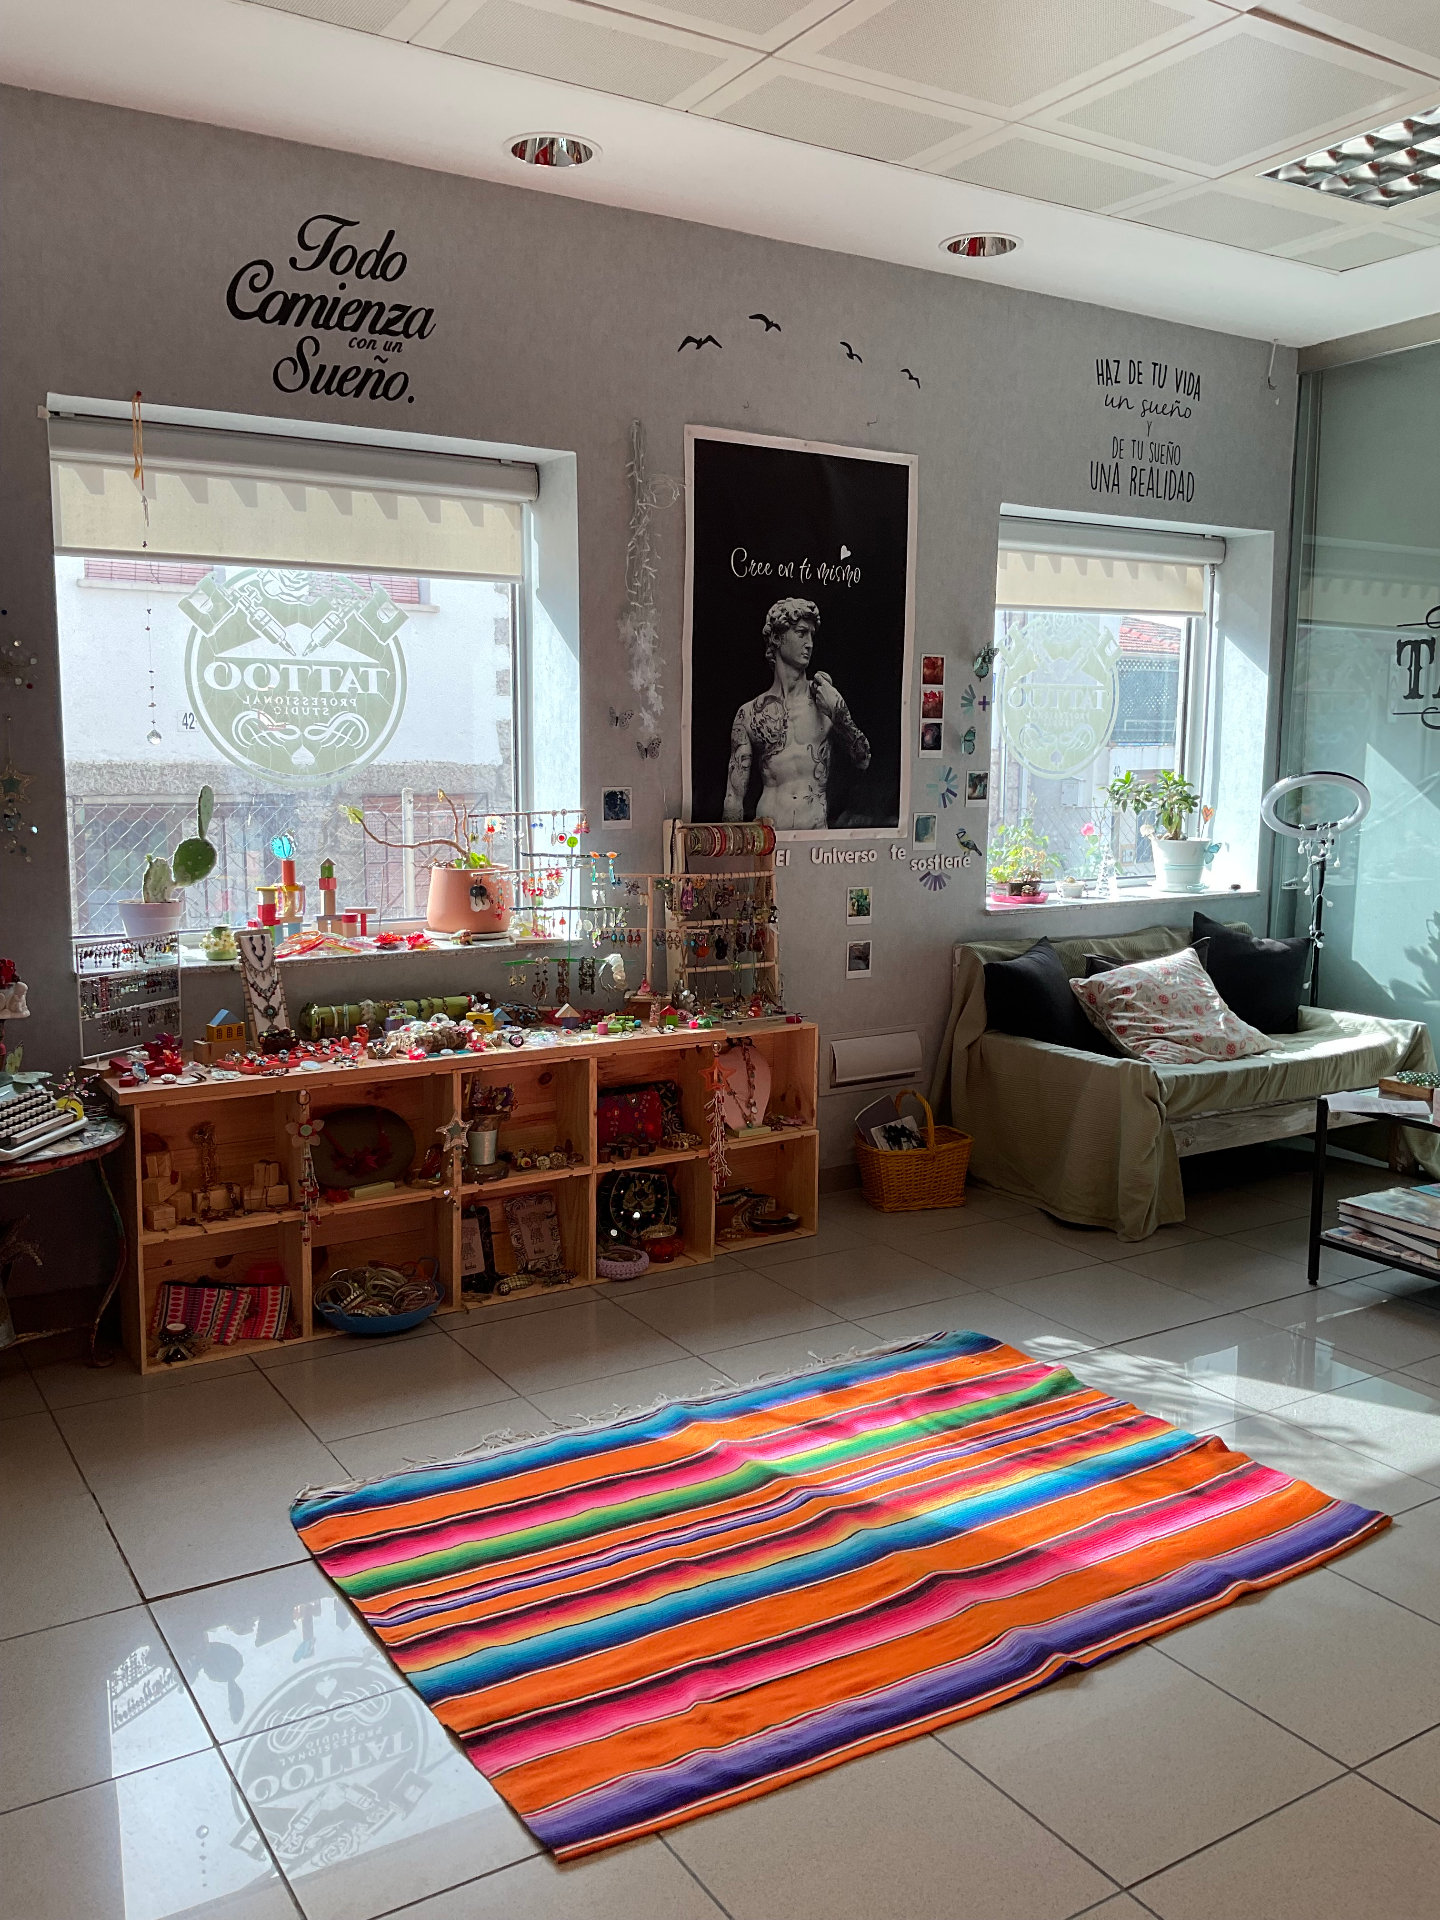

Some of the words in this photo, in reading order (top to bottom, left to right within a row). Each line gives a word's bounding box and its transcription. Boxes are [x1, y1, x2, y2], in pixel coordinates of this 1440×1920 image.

[288, 214, 408, 282] Todo
[226, 259, 437, 340] Comienza
[348, 336, 378, 351] con
[382, 340, 404, 353] un
[272, 335, 415, 404] Sueño.
[1096, 358, 1121, 387] HAZ
[1128, 359, 1143, 385] DE
[1151, 362, 1168, 389] TU
[1175, 367, 1201, 402] VIDA
[1104, 393, 1135, 410] un
[1140, 400, 1192, 419] sueño
[1112, 436, 1125, 460] DE
[1131, 439, 1144, 461] TU
[1149, 441, 1181, 466] SUEÑO
[1090, 460, 1120, 495] UNA
[1129, 466, 1195, 503] REALIDAD
[730, 547, 774, 578] Cree
[778, 561, 794, 579] en
[799, 557, 813, 584] ti
[816, 562, 861, 588] mismo
[1396, 636, 1440, 700] T
[181, 712, 196, 730] 42
[775, 849, 791, 867] El
[890, 844, 907, 861] te
[279, 1725, 383, 1766] PROFESSIONAL
[305, 1726, 358, 1749] STUDIO
[246, 1730, 414, 1803] TATTOO
